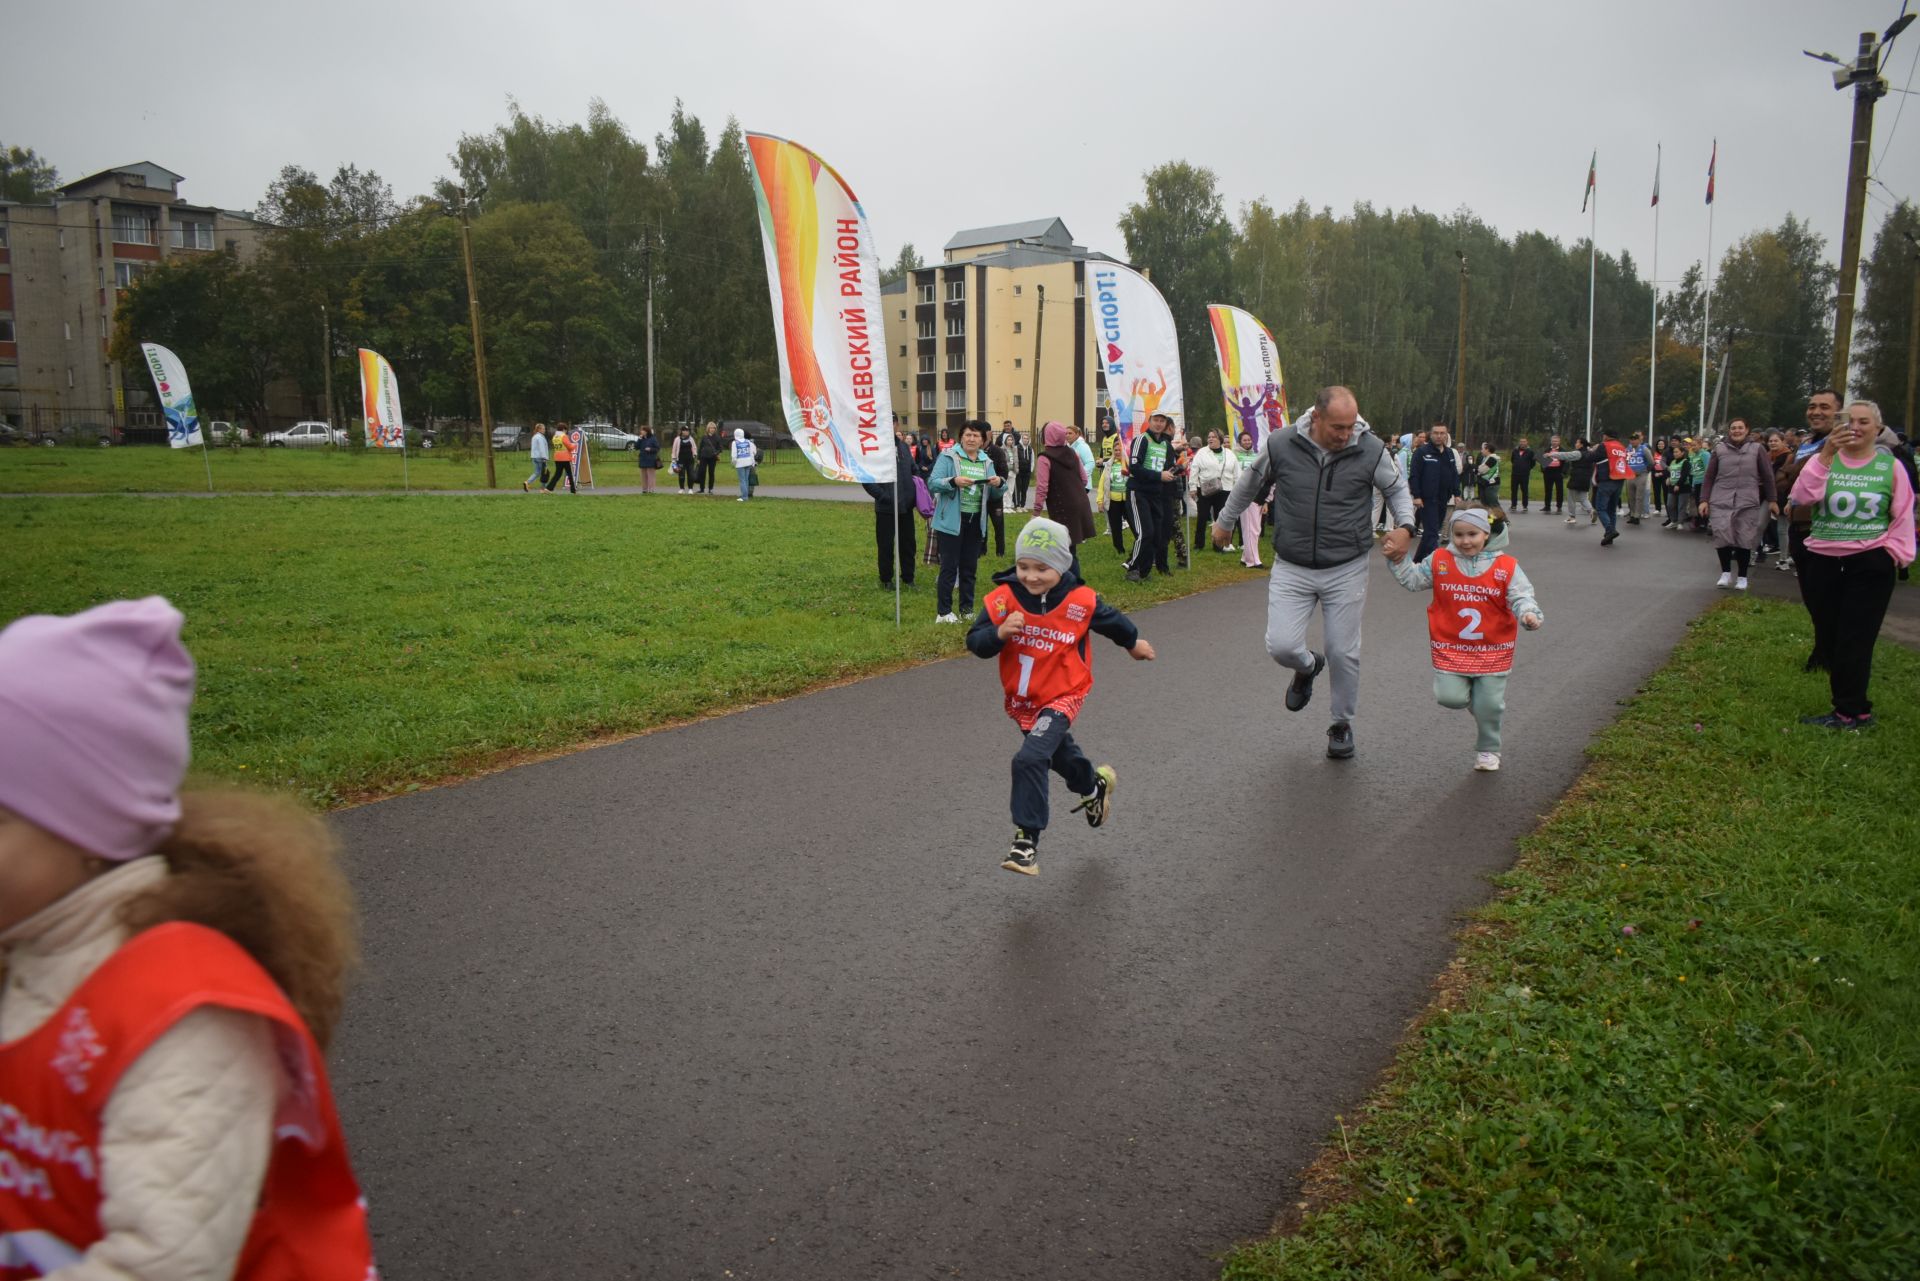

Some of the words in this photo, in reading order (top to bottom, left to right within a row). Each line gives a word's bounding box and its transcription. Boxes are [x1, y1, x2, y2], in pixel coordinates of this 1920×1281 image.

[833, 218, 863, 297] РАЙОН
[1259, 333, 1271, 367] СПОРТА!
[1108, 363, 1124, 375] Я
[839, 307, 880, 456] ТУКАЕВСКИЙ
[1150, 456, 1166, 472] 15
[1828, 472, 1884, 482] КАЕВСКИЙ
[1440, 583, 1501, 598] ТУКАЕВСКИЙ
[1453, 592, 1488, 603] РАЙОН
[1457, 607, 1484, 641] 2
[1011, 634, 1054, 653] РАЙОН
[1020, 624, 1076, 645] ЕВСКИЙ
[1018, 653, 1035, 698] 1
